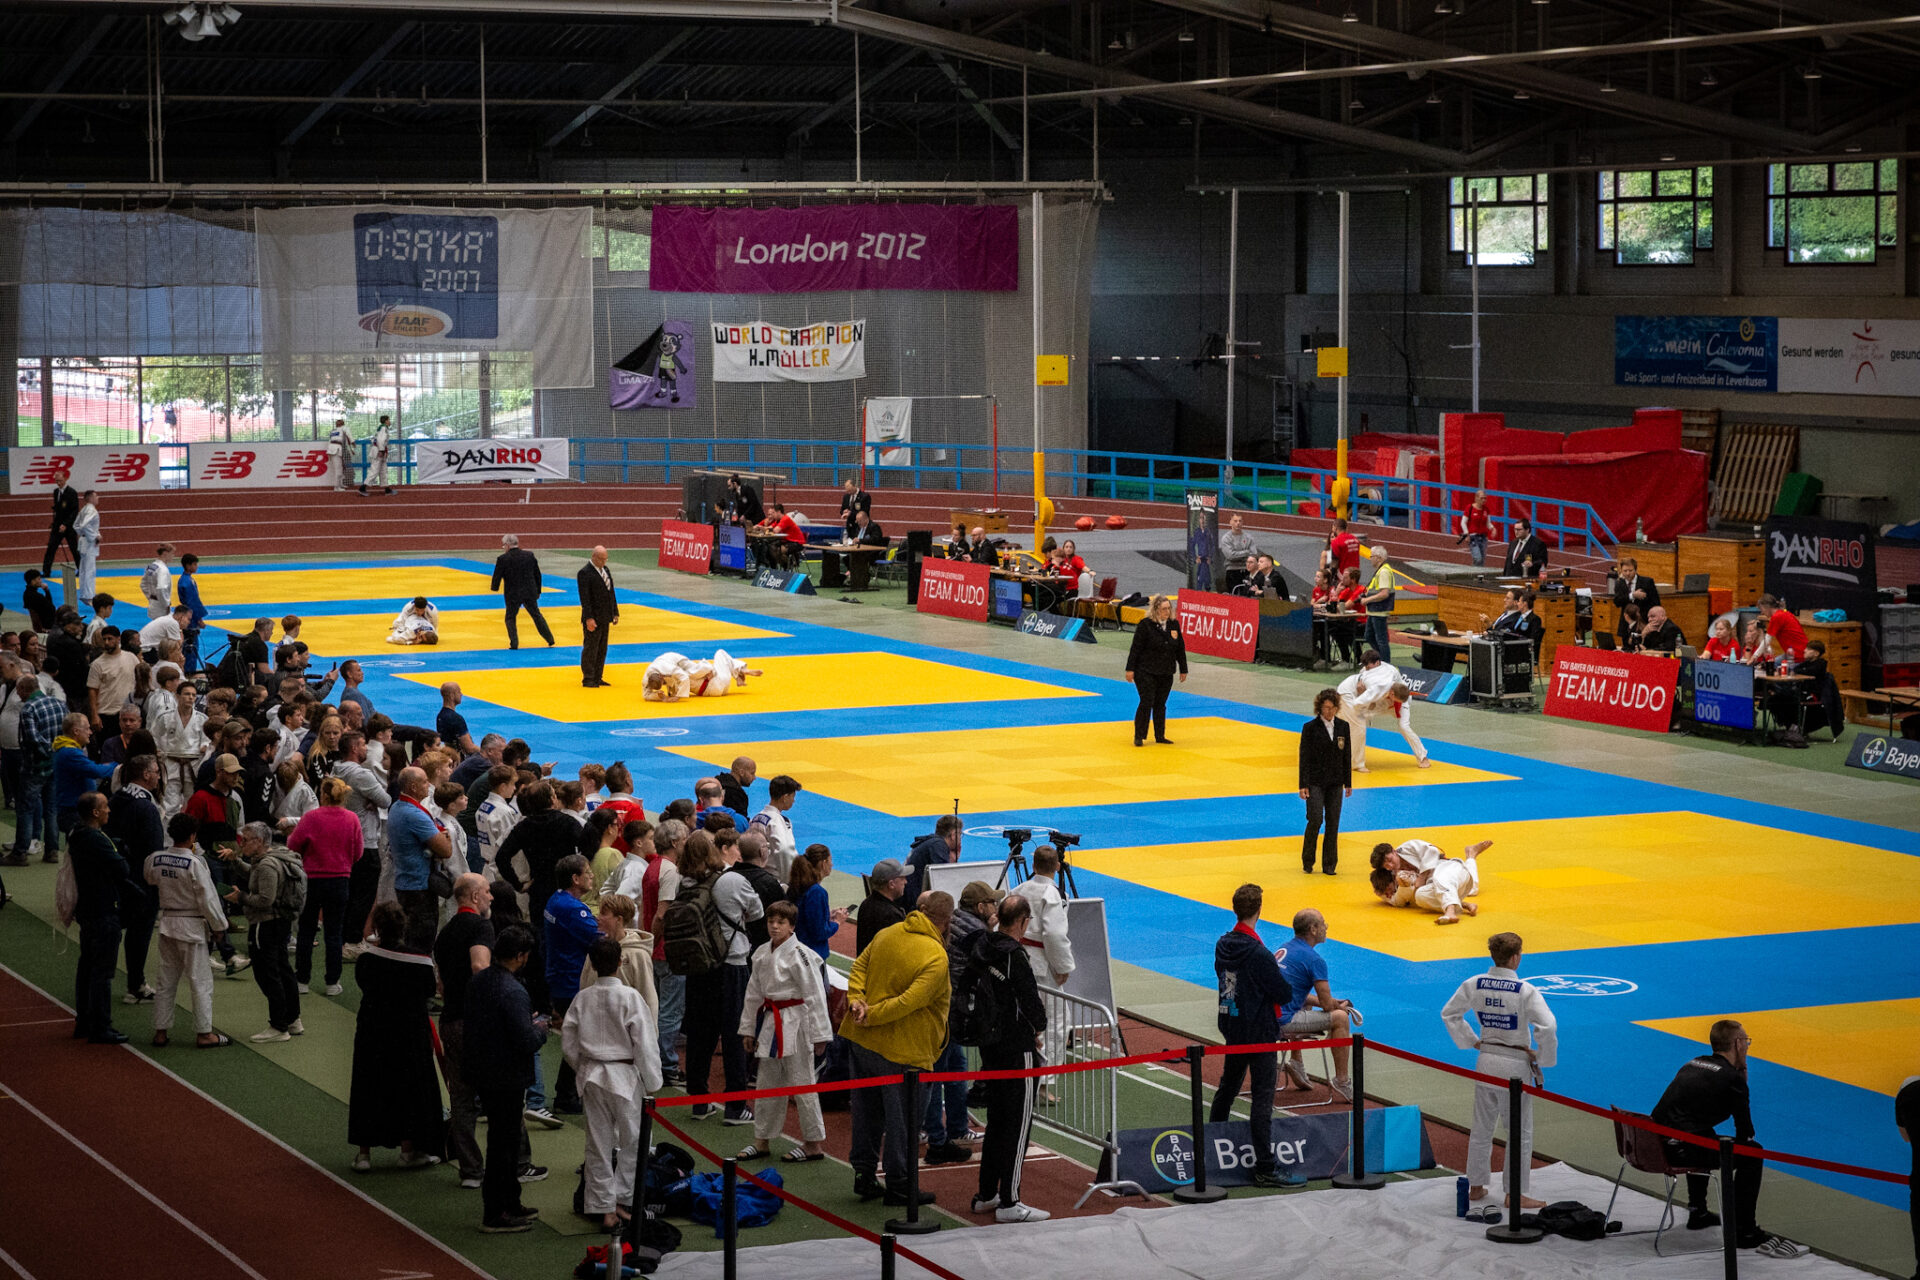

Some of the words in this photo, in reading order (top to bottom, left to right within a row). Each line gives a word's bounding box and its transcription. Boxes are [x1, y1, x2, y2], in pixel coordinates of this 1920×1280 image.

[734, 233, 848, 264] London
[857, 232, 926, 260] 2012
[422, 269, 480, 293] 2007
[394, 316, 430, 326] IAAF
[714, 326, 772, 344] WORLD
[780, 323, 864, 346] CHAMPION
[749, 348, 830, 368] H.MÜLLER
[1782, 345, 1812, 358] Gesund
[1814, 346, 1844, 358] werden
[1624, 371, 1637, 382] Das
[1638, 372, 1659, 384] Sport-
[1661, 373, 1675, 384] und
[1676, 373, 1715, 386] Freizeitbad
[1717, 374, 1724, 385] in
[1725, 375, 1768, 388] Leverkusen
[443, 448, 542, 474] DANRHO
[663, 538, 685, 558] TEAM
[685, 542, 709, 561] JUDO
[1770, 530, 1864, 570] DANRHO
[767, 575, 784, 589] Bayer
[923, 578, 953, 601] TEAM
[954, 584, 985, 606] JUDO
[1034, 619, 1056, 636] Bayer
[1180, 612, 1214, 638] TEAM
[1216, 619, 1253, 645] JUDO
[1560, 660, 1570, 670] TSV
[1569, 662, 1587, 672] BAYER
[1586, 664, 1595, 673] 04
[1595, 665, 1630, 678] LEVERKUSEN
[1697, 671, 1720, 690] 000
[1557, 672, 1607, 704] TEAM
[1609, 680, 1666, 712] JUDO
[1697, 703, 1720, 721] 000
[162, 869, 178, 879] BEL
[1480, 979, 1517, 991] PALMAERTS
[1485, 997, 1505, 1007] BEL
[1156, 1151, 1194, 1164] BAYE
[1214, 1138, 1307, 1170] Baer
